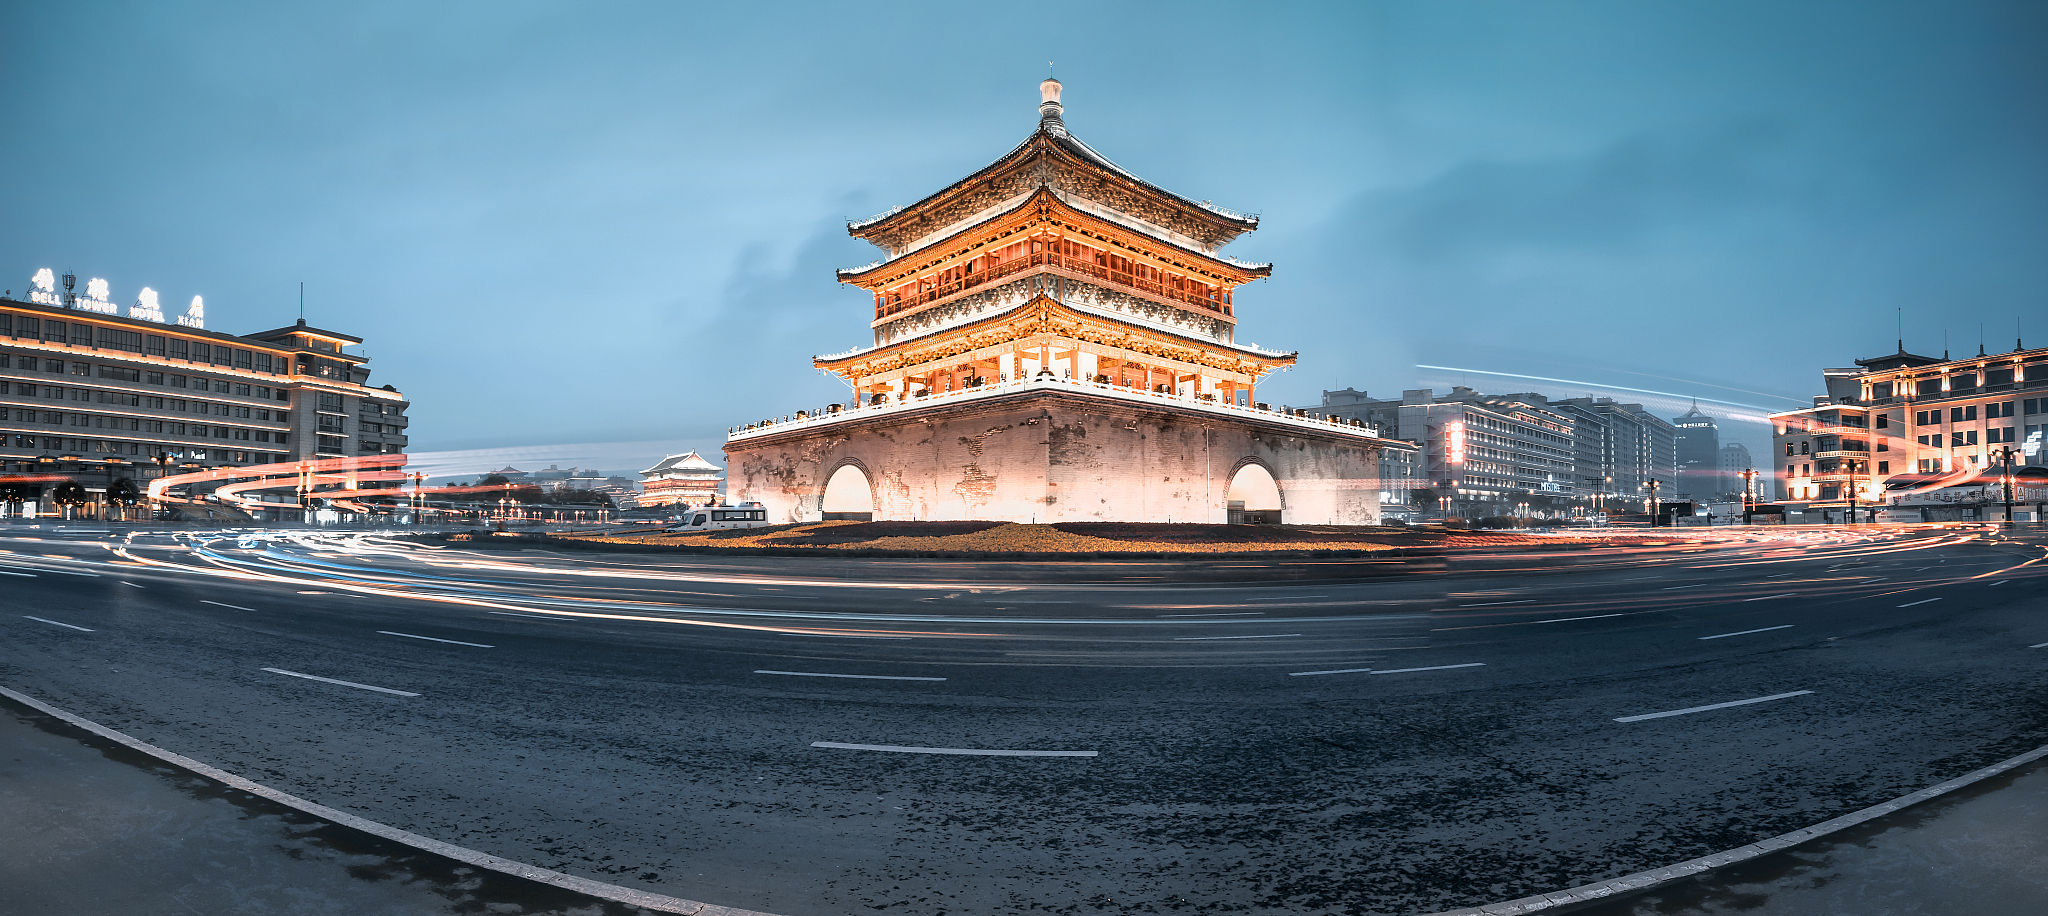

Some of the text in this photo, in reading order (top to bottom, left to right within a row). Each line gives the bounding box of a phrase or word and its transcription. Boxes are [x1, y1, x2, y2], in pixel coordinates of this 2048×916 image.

[32, 291, 62, 306] BELL
[75, 297, 118, 314] TOWER
[130, 306, 165, 323] HOTEL
